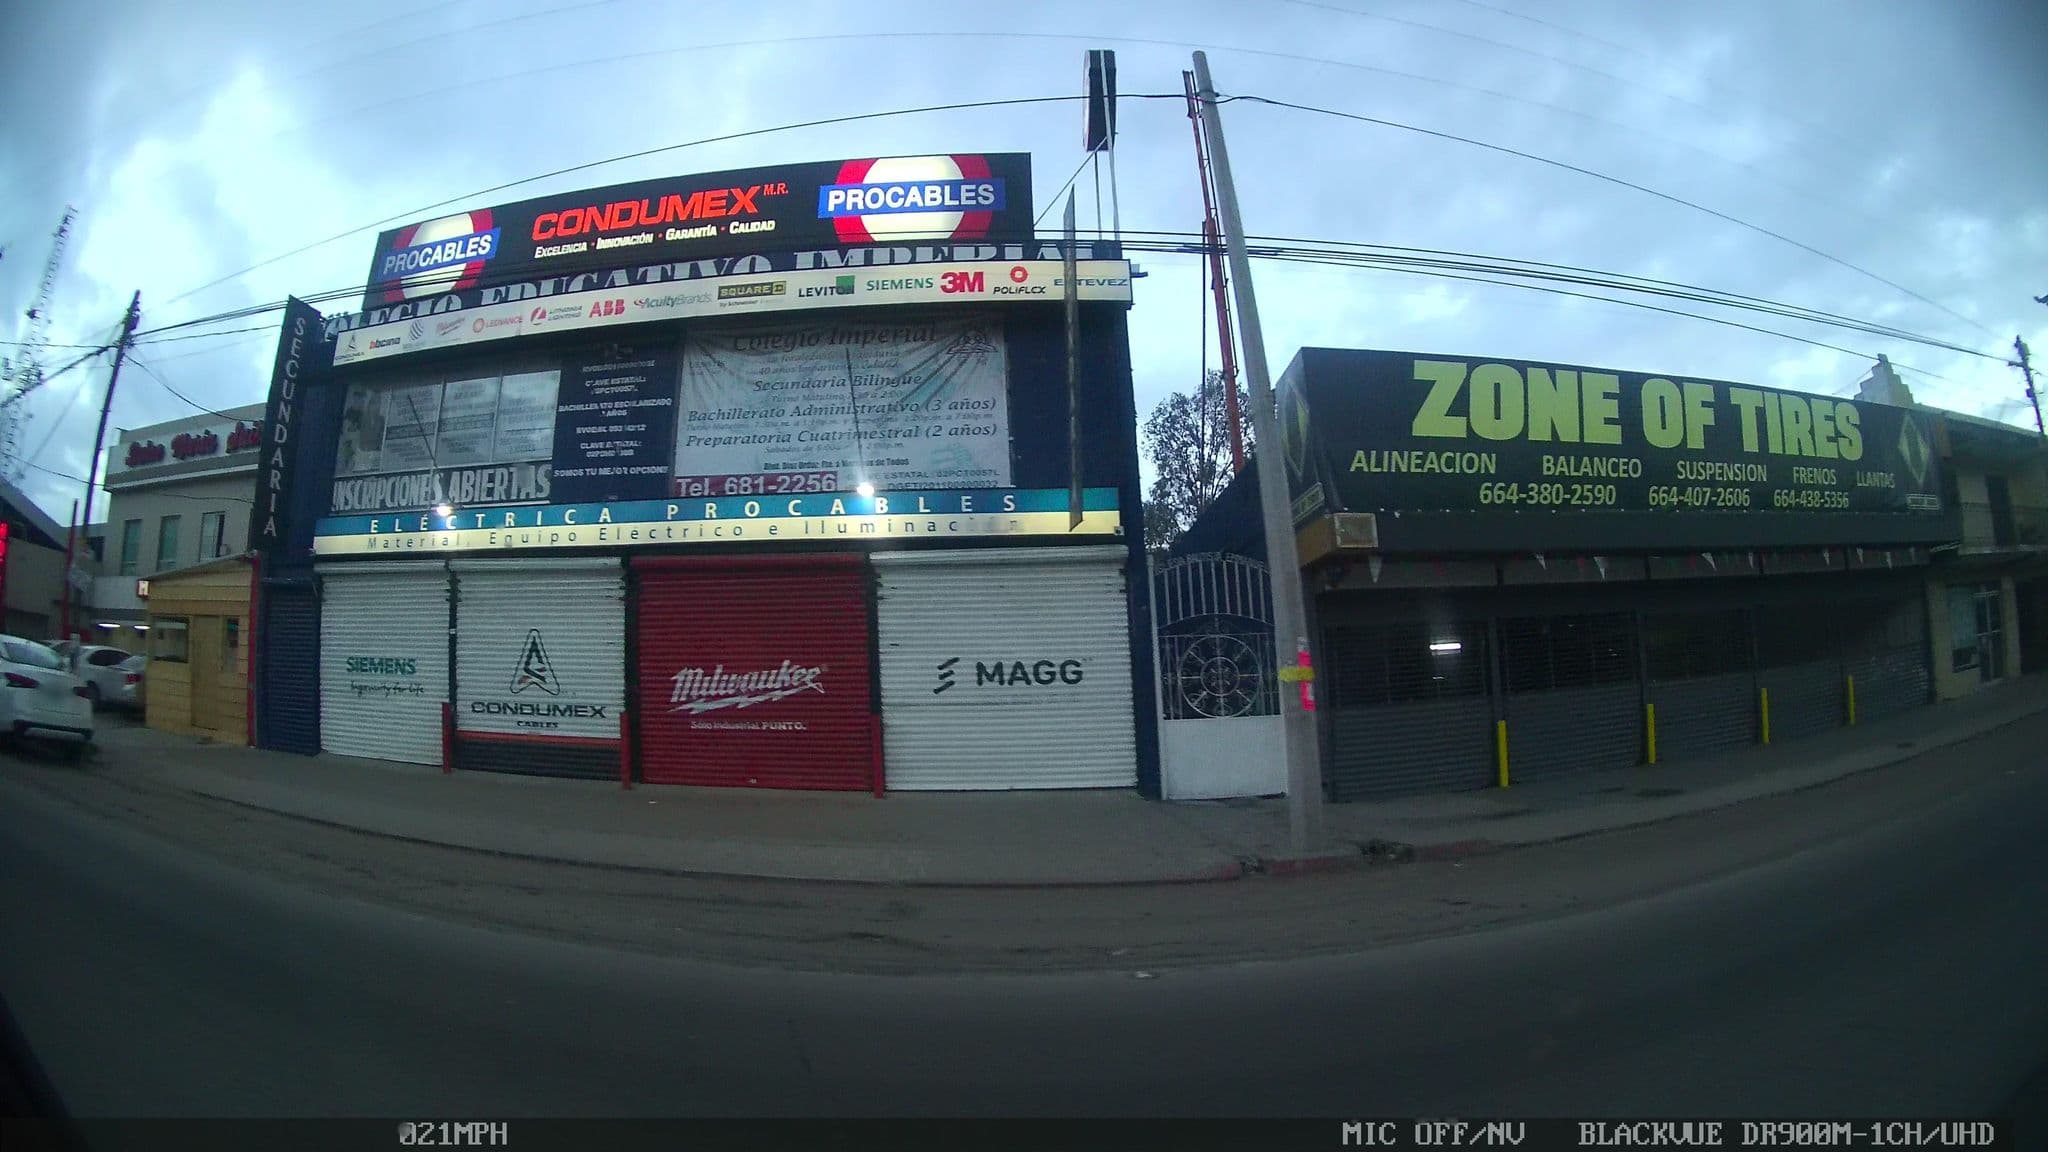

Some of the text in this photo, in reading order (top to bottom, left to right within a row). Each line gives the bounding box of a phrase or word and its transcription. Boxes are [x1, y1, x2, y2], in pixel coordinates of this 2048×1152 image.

[827, 184, 995, 212] PROCABLES
[532, 182, 789, 241] CONDUMEX M.R.
[729, 220, 776, 235] CALIDAD
[383, 234, 492, 275] PROCABLES
[720, 285, 772, 297] SQUARE
[866, 277, 934, 292] SIEMENS
[940, 271, 985, 294] 3M
[1054, 278, 1128, 287] ETEVEZ
[589, 298, 626, 318] ABB
[753, 376, 847, 392] Secundaria
[687, 407, 786, 422] Bachillerato
[790, 402, 920, 418] Administrativo
[1412, 359, 1863, 461] ZONE OF TIRES
[263, 317, 307, 537] SECUNDARIA
[686, 431, 792, 448] Preparatoria
[797, 425, 920, 443] Cuatrimestral
[949, 424, 997, 437] años)
[1350, 450, 1896, 489] ALINEACION BALANCEO SUSPENSION FRENOS LLANTAS
[331, 474, 444, 512] INSCRIPCIONES
[676, 474, 837, 497] Tel. 681-2256
[1479, 482, 1849, 508] 664-380-2590 664-407-2606 664-438-5356
[370, 494, 1016, 533] ELÉCTRICA PROCABLES
[346, 656, 417, 675] SIEMENS
[975, 659, 1084, 687] MAGG
[670, 659, 822, 703] Milwaukee
[471, 701, 607, 718] CONDUMEX
[516, 720, 559, 728] CABLES
